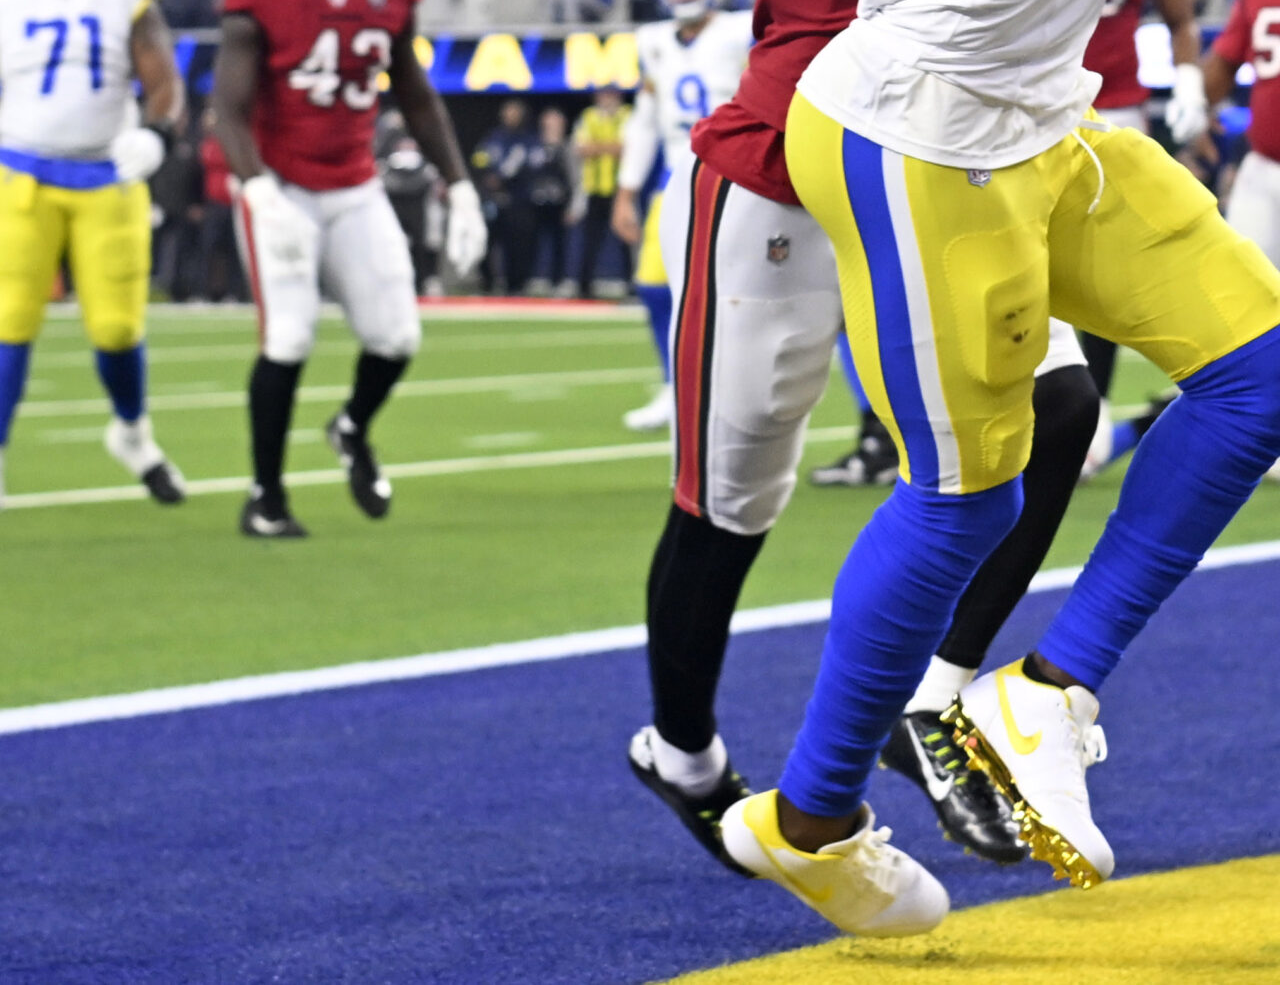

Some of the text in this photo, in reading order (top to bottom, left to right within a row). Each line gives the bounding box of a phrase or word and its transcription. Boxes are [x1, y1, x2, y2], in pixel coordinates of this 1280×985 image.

[24, 15, 103, 95] 71
[288, 28, 392, 109] 43
[674, 72, 710, 131] 9
